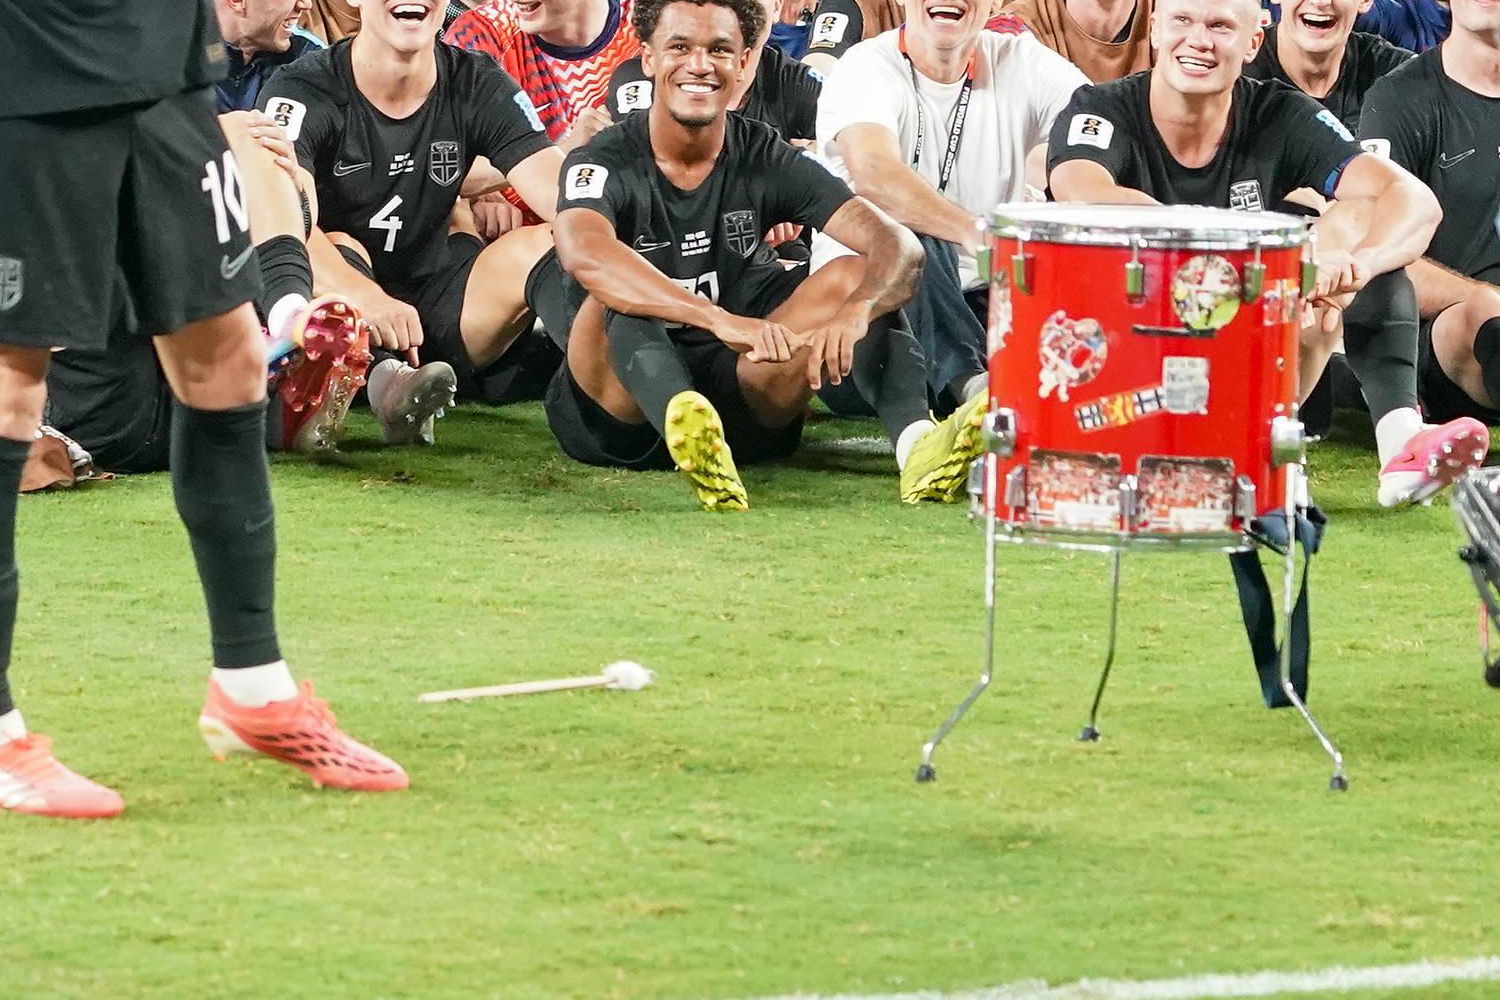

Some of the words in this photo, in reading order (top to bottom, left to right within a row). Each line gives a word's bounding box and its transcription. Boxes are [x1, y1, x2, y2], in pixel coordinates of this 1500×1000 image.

[960, 86, 970, 104] FIFA
[953, 105, 966, 134] WORLD
[949, 134, 959, 152] CUP
[942, 151, 954, 181] 2026
[201, 149, 249, 244] 10
[368, 194, 403, 253] 4
